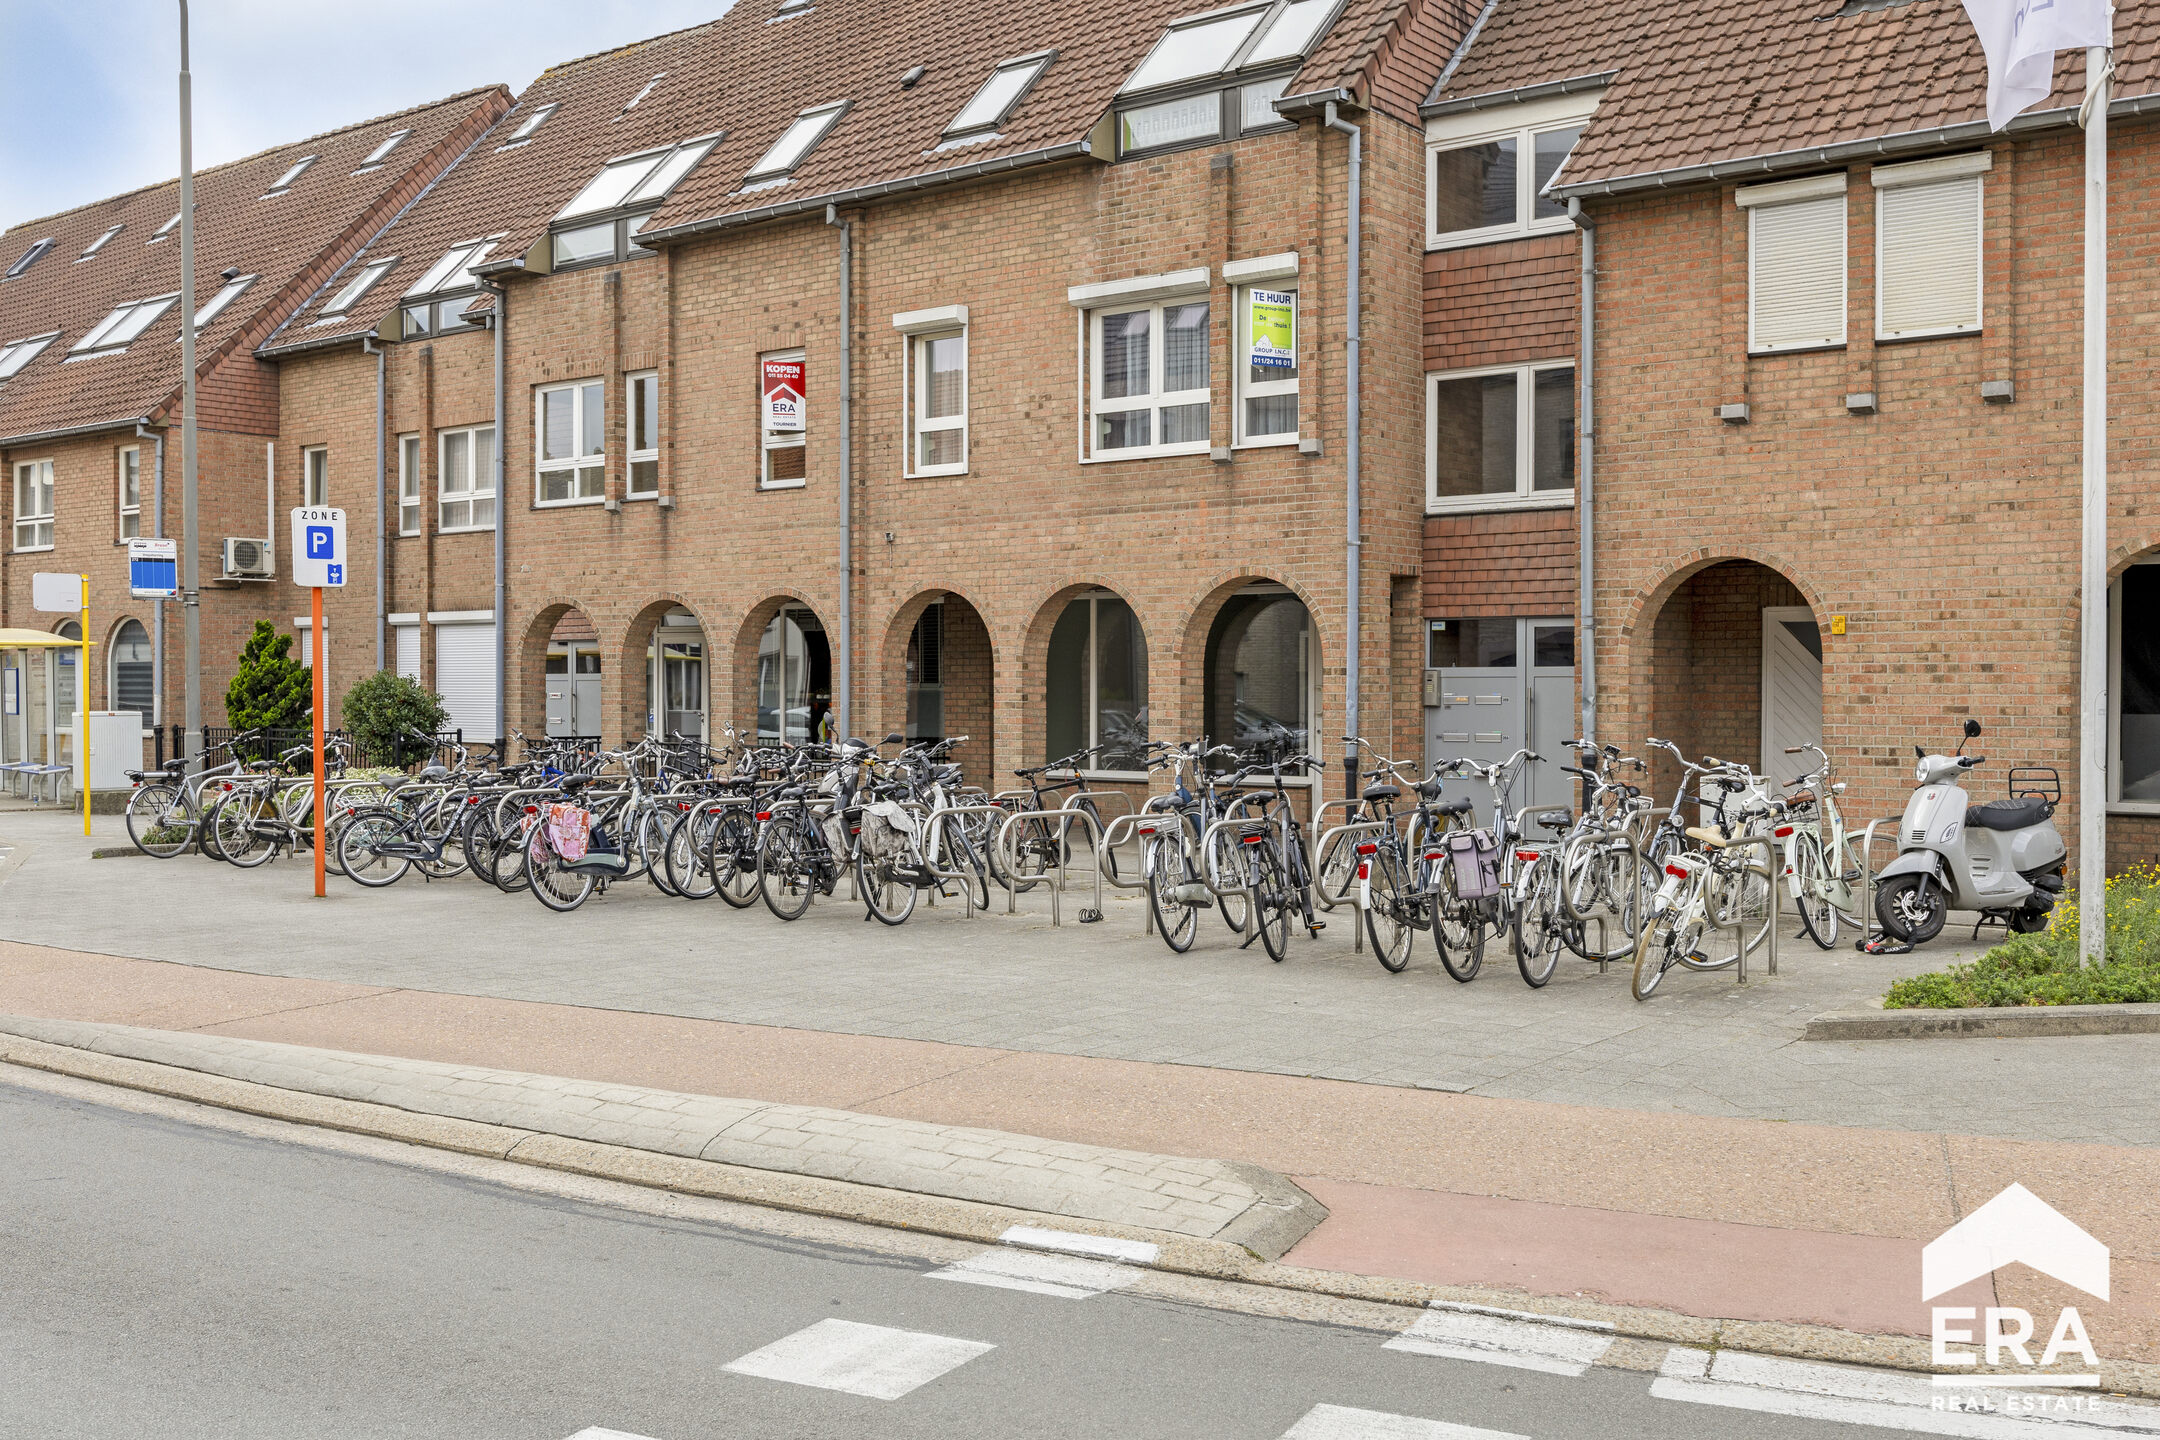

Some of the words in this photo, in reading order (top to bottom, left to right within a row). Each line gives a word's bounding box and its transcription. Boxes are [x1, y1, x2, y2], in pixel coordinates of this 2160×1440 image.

[1254, 292, 1264, 301] TE
[1267, 293, 1291, 304] HUUR
[766, 365, 800, 374] KOPEN
[773, 404, 795, 412] ERA
[302, 511, 337, 520] ZONE
[313, 532, 327, 553] P
